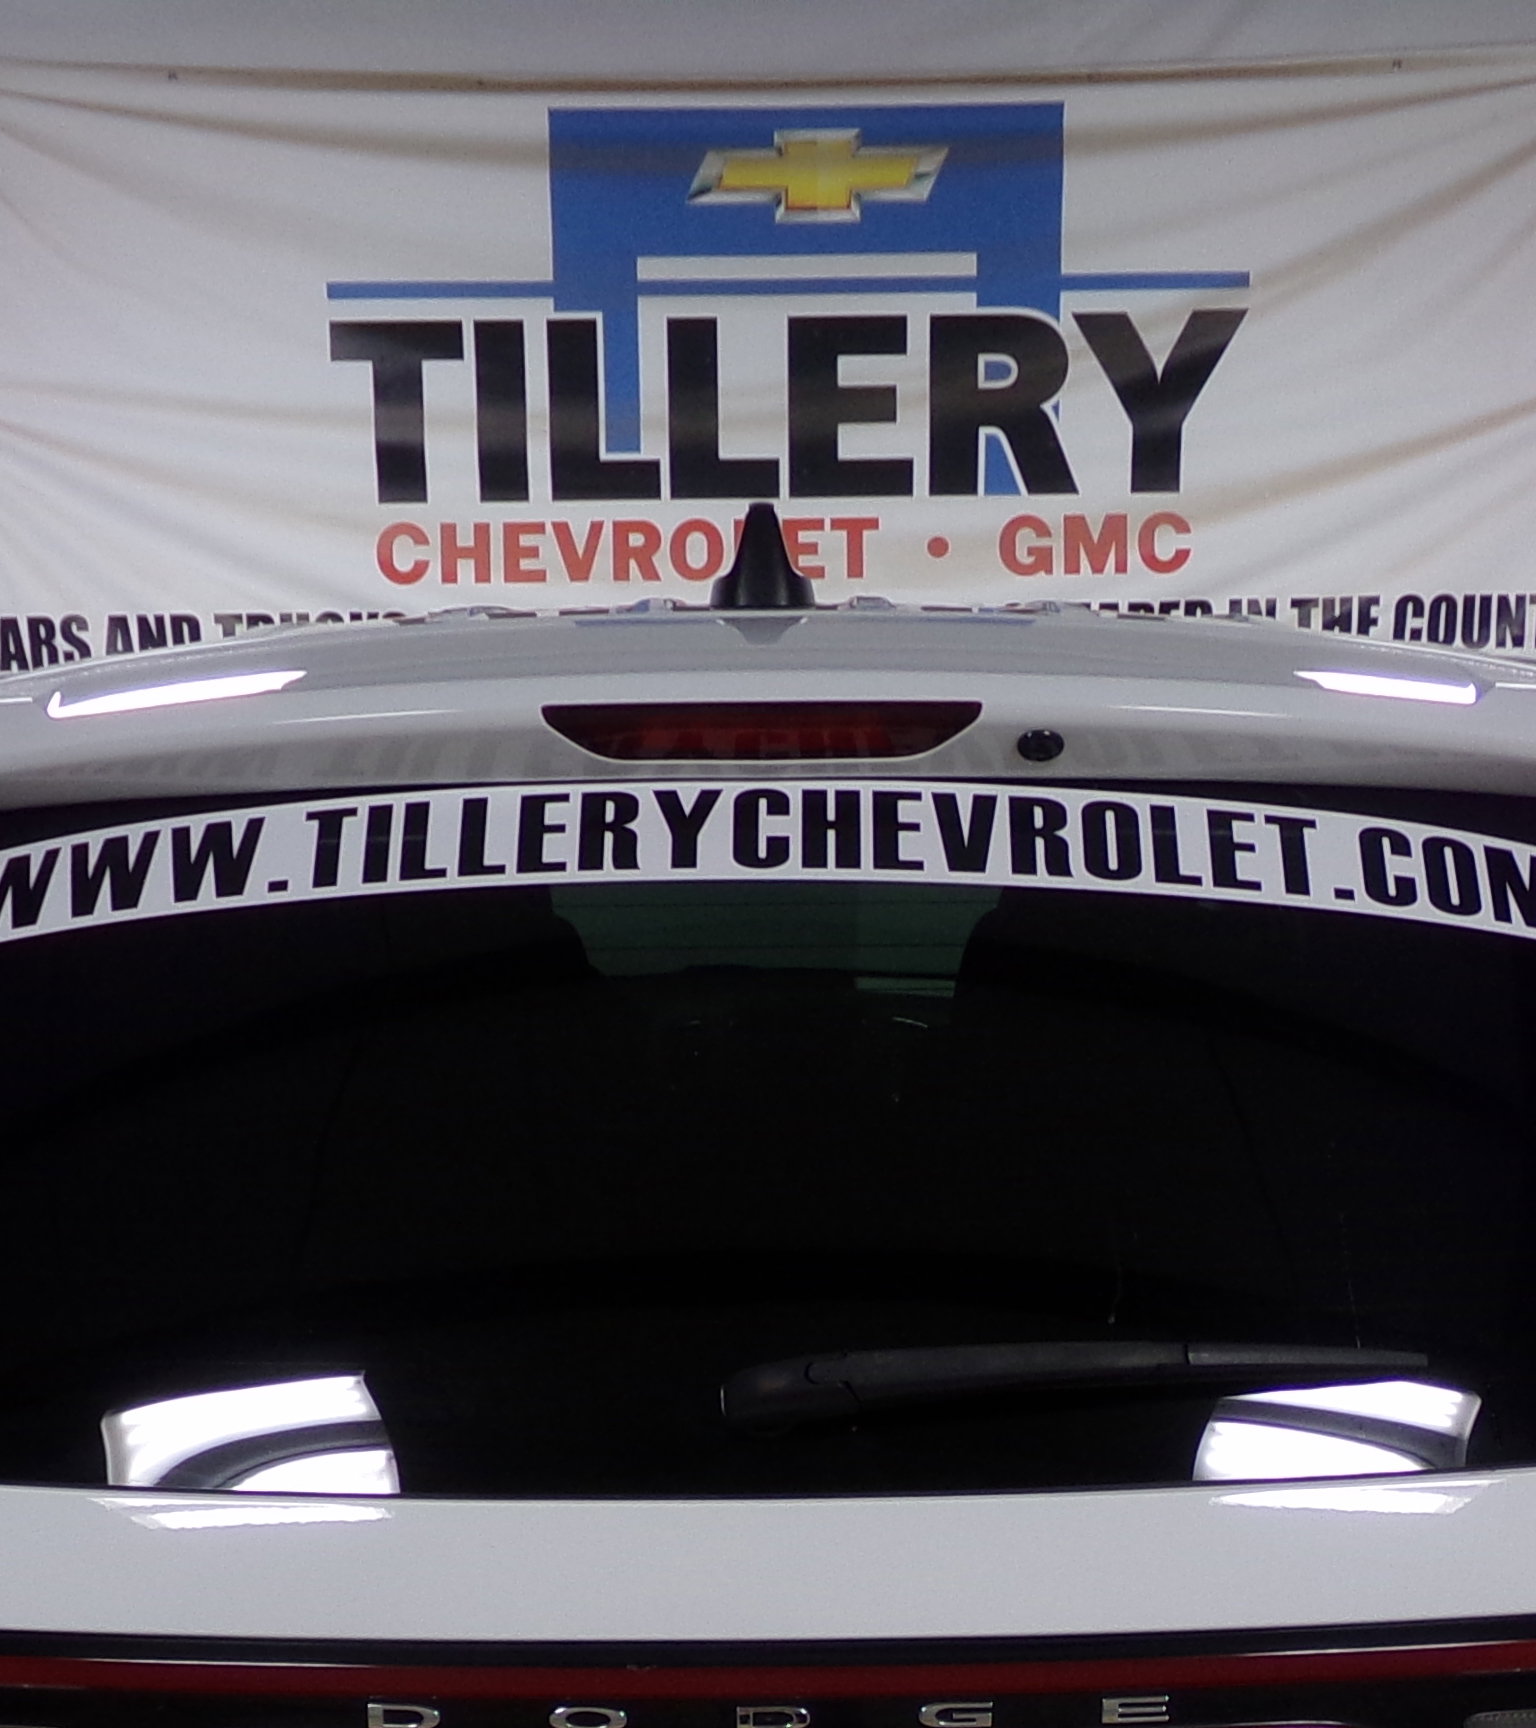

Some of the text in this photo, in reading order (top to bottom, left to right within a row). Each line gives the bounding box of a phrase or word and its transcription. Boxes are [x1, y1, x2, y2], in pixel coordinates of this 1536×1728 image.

[328, 308, 1250, 504] TILLERY
[376, 511, 1193, 585] CHEVROET GMC
[105, 612, 203, 656] AND
